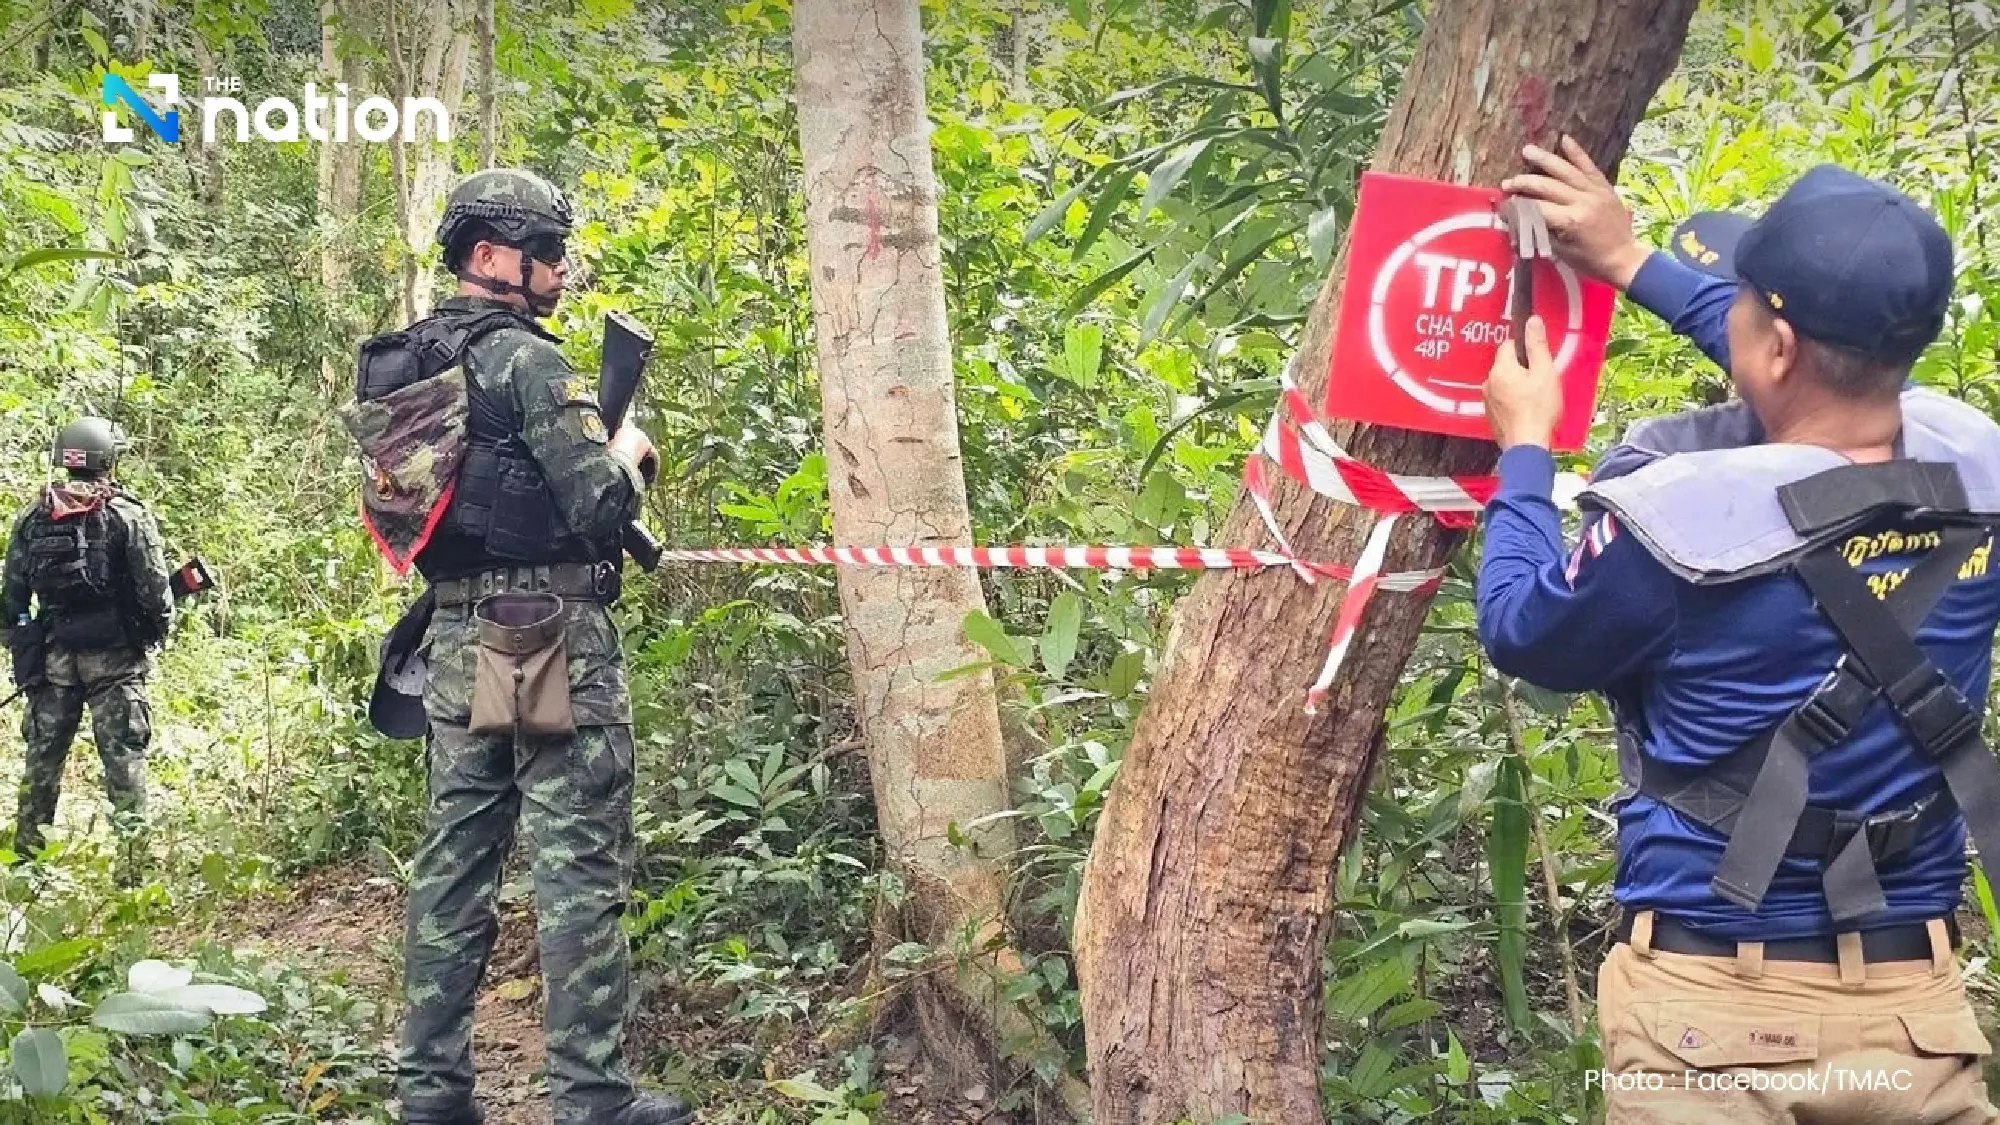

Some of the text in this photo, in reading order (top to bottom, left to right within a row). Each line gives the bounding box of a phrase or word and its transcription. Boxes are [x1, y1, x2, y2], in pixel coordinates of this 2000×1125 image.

[1414, 252, 1496, 313] TP
[1416, 314, 1455, 338] CHA
[1414, 339, 1450, 360] 48P
